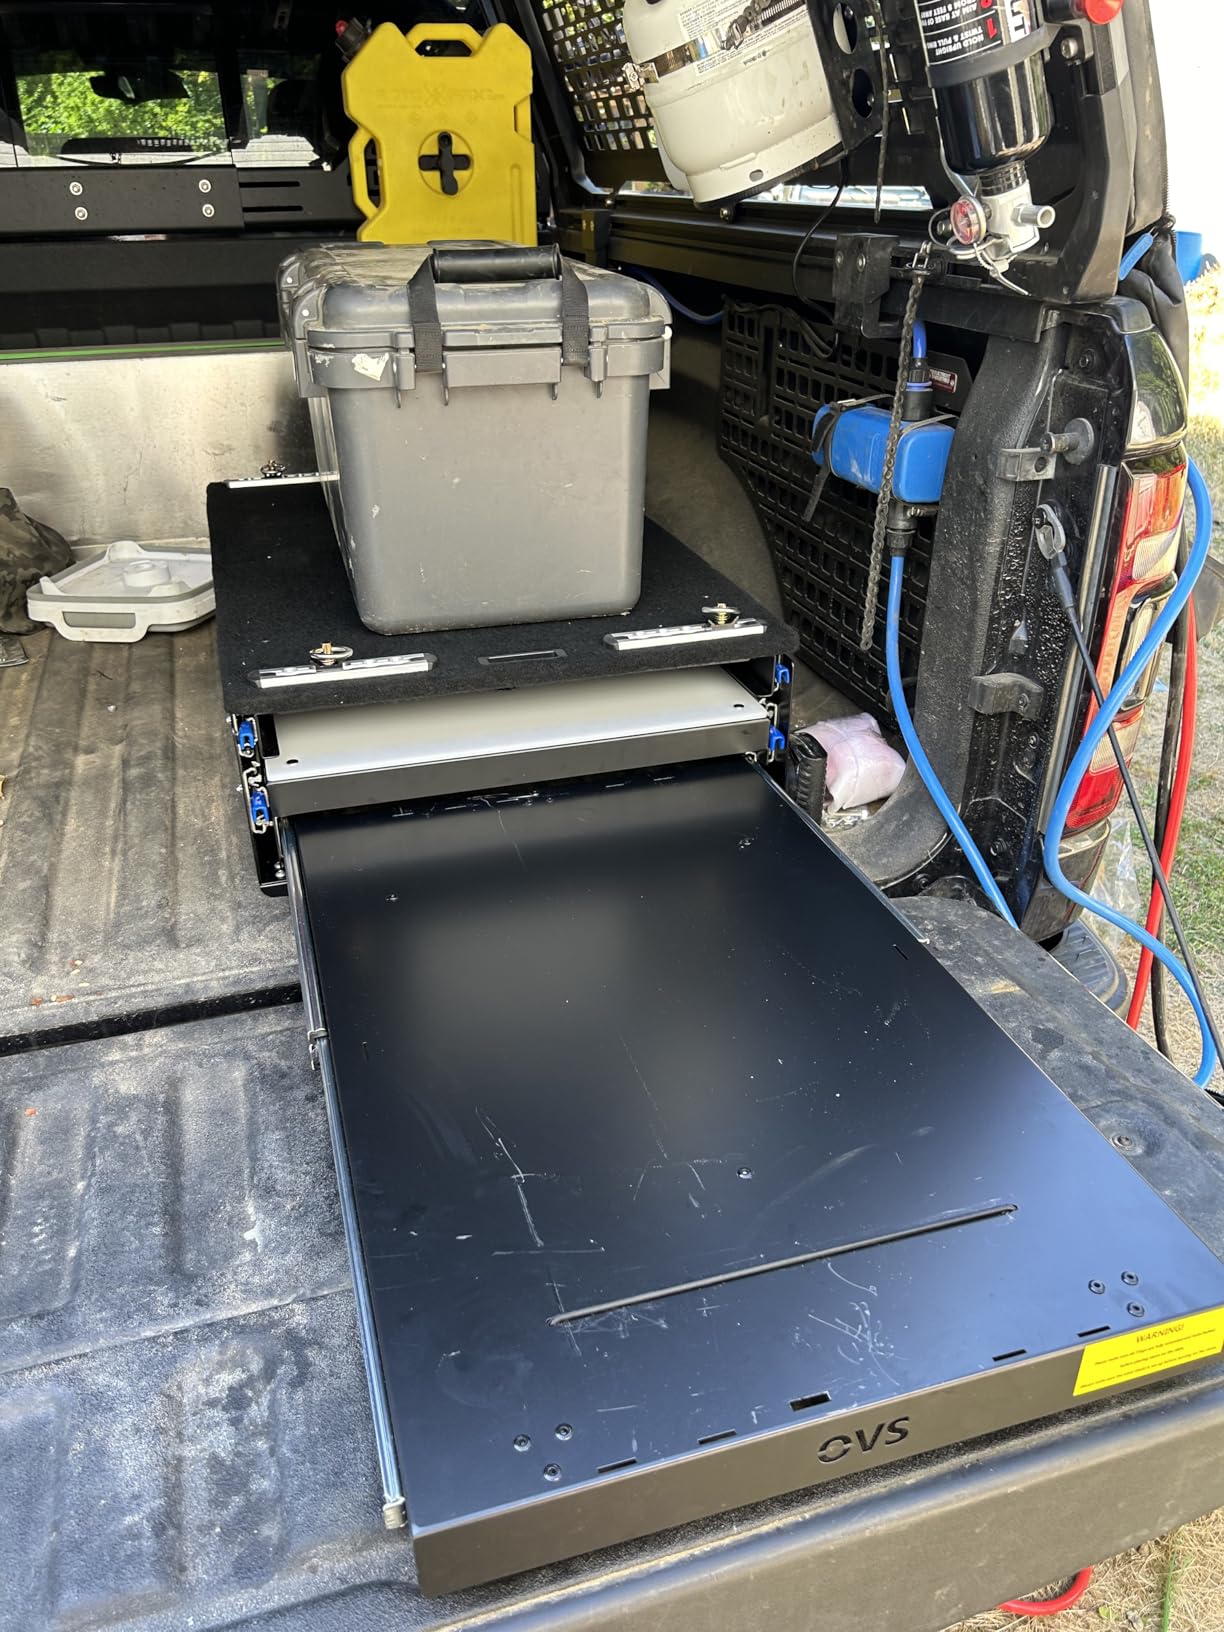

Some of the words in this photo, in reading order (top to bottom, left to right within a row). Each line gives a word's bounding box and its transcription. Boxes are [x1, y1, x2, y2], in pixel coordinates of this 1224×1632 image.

[933, 5, 947, 16] FEET
[951, 8, 961, 19] AT
[962, 3, 977, 15] AIM
[935, 13, 951, 24] BASE
[960, 26, 983, 38] TWIST
[986, 17, 997, 39] 1
[939, 36, 953, 46] PULL
[953, 34, 959, 42] &
[963, 33, 985, 47] HOLD
[935, 41, 963, 56] UPRIGHT
[1136, 1323, 1185, 1344] WARNING!
[818, 1416, 909, 1463] OVS
